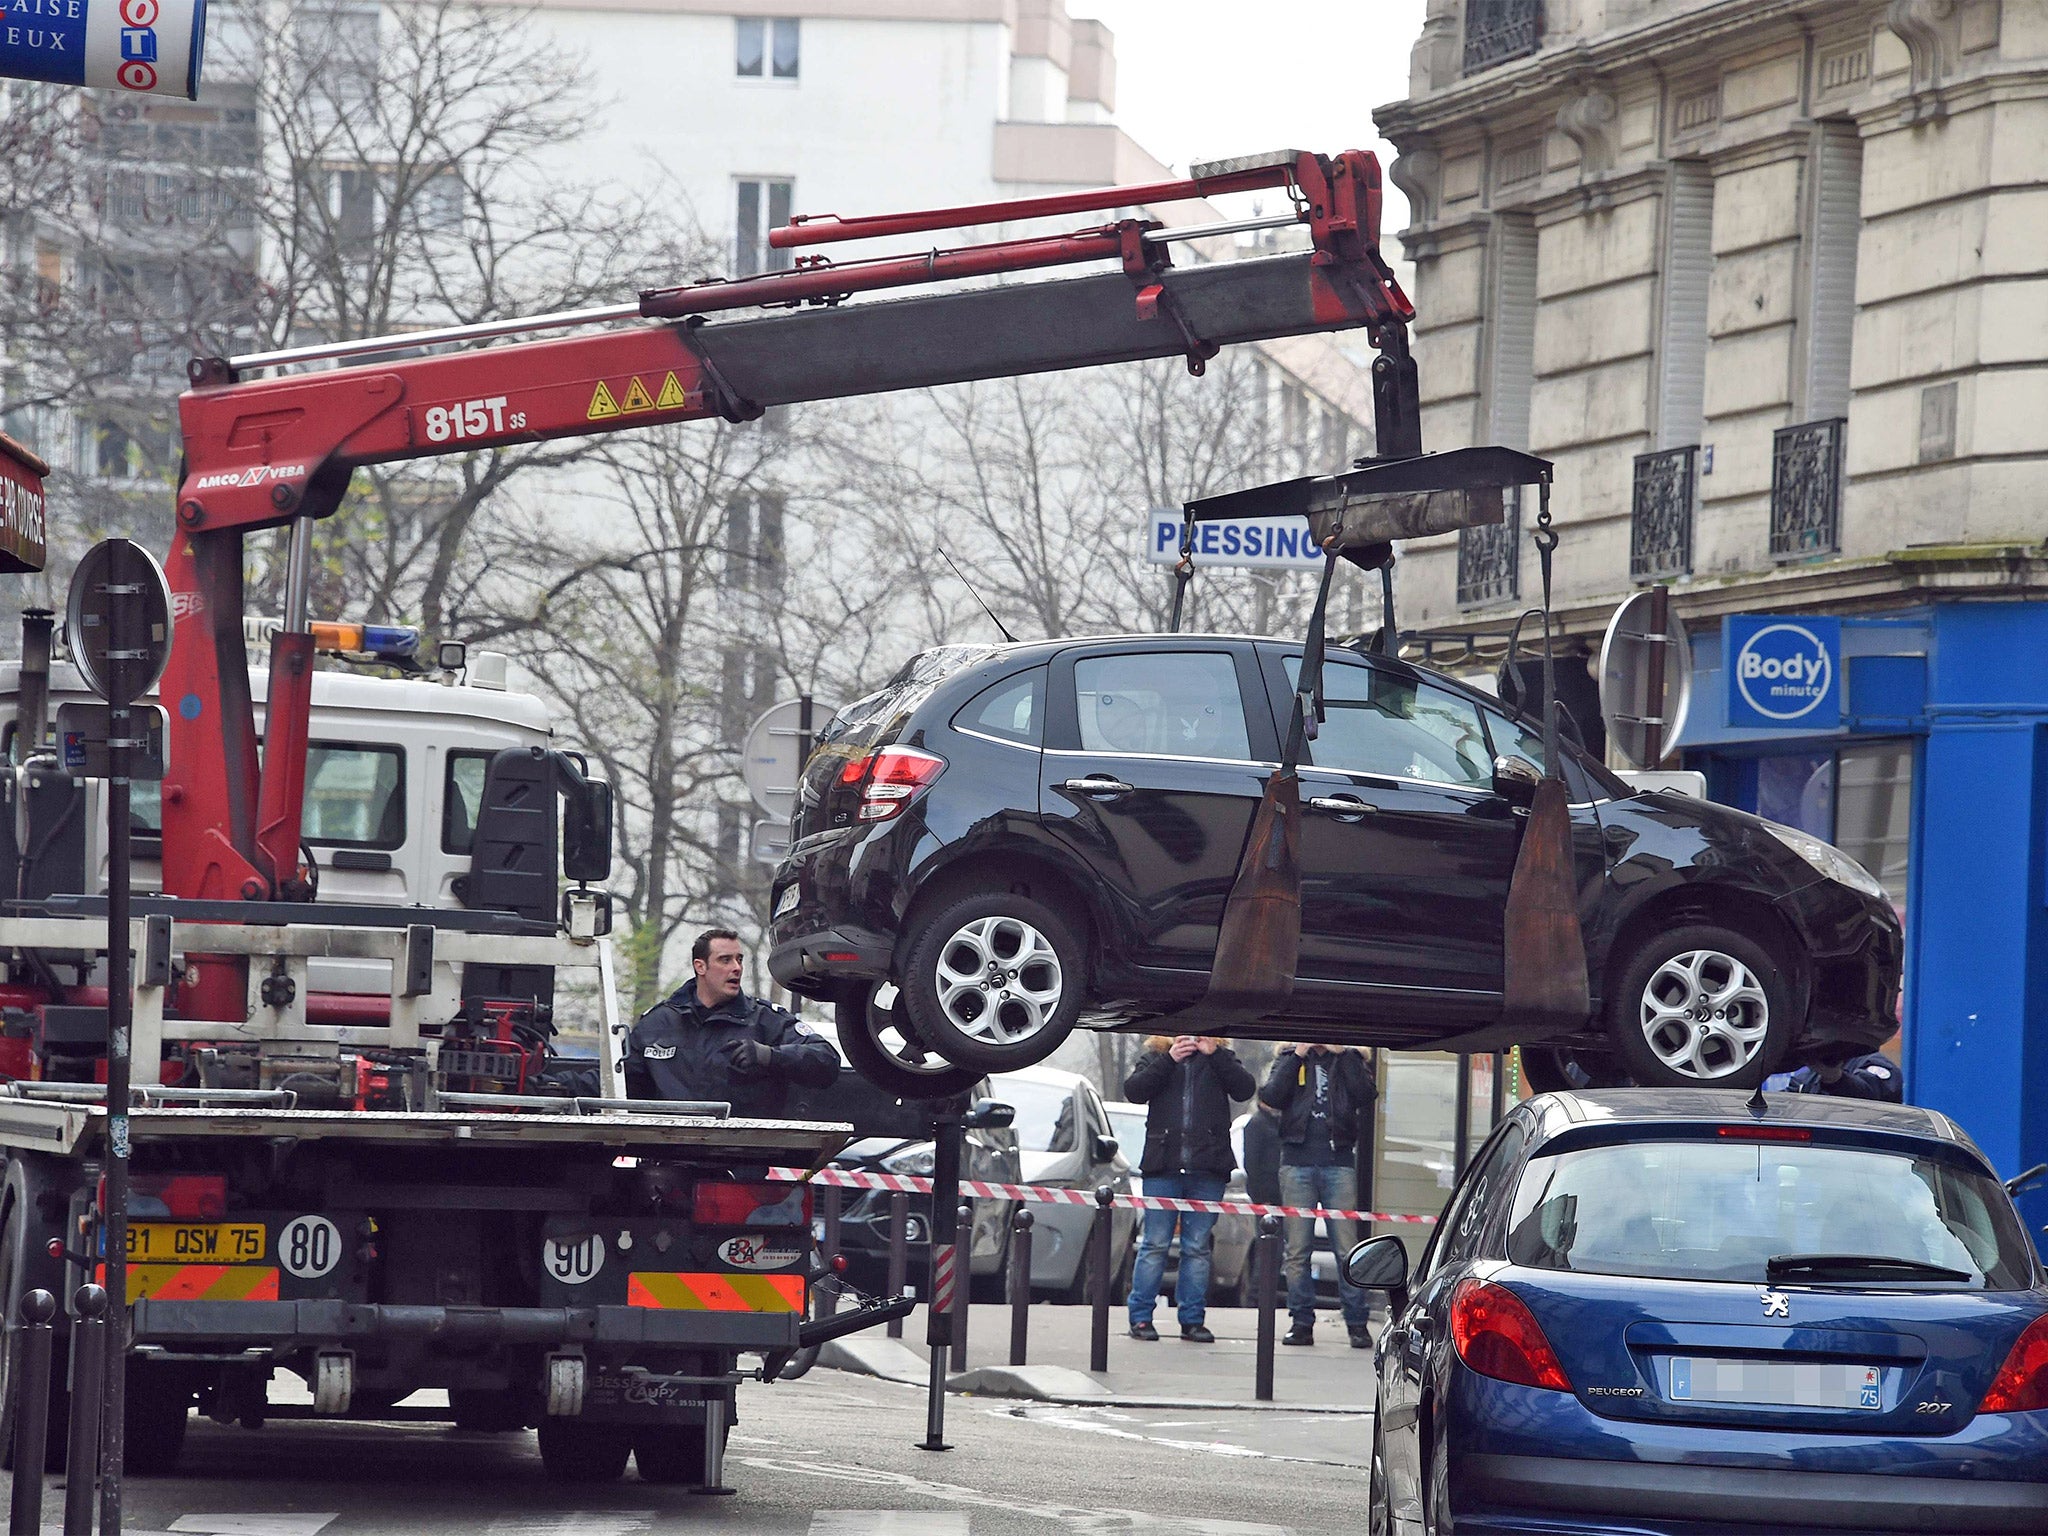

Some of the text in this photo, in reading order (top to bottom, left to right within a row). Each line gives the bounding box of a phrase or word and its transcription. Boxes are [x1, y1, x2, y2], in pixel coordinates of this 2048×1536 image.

[425, 396, 526, 442] 815T 3S
[197, 465, 305, 489] AMCO VEBA
[1770, 683, 1821, 697] minute
[645, 1048, 675, 1057] POLICE
[175, 1229, 218, 1254] QSW
[230, 1229, 259, 1254] 75
[290, 1223, 330, 1271] 80
[555, 1238, 594, 1277] 90
[1588, 1386, 1643, 1397] PEUGEOT
[1860, 1389, 1877, 1405] 75
[1916, 1401, 1952, 1416] 207
